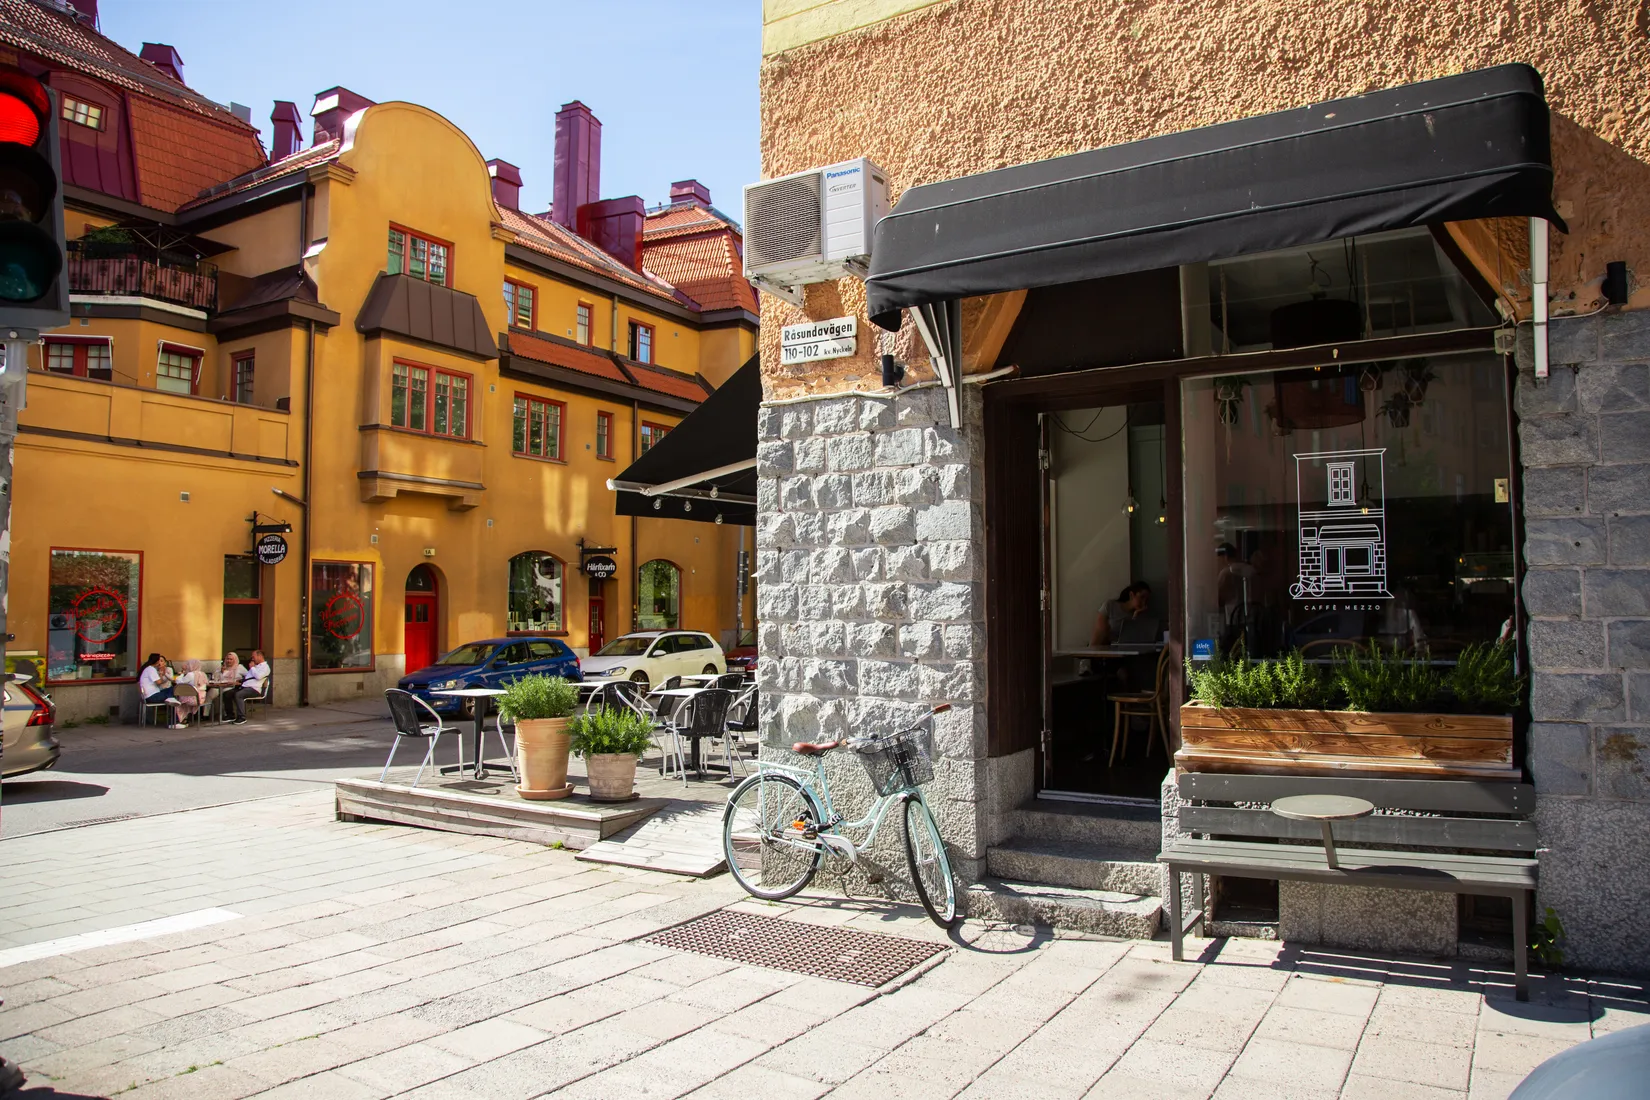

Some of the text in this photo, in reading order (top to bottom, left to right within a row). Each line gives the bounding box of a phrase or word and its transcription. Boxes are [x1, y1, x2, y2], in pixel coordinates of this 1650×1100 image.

[826, 167, 861, 179] Panasonic
[829, 183, 857, 192] INVERTER
[784, 323, 853, 341] Råsundavägen
[785, 344, 819, 360] 110-102
[263, 535, 281, 543] PIZZERIA
[258, 544, 286, 554] MORELLA
